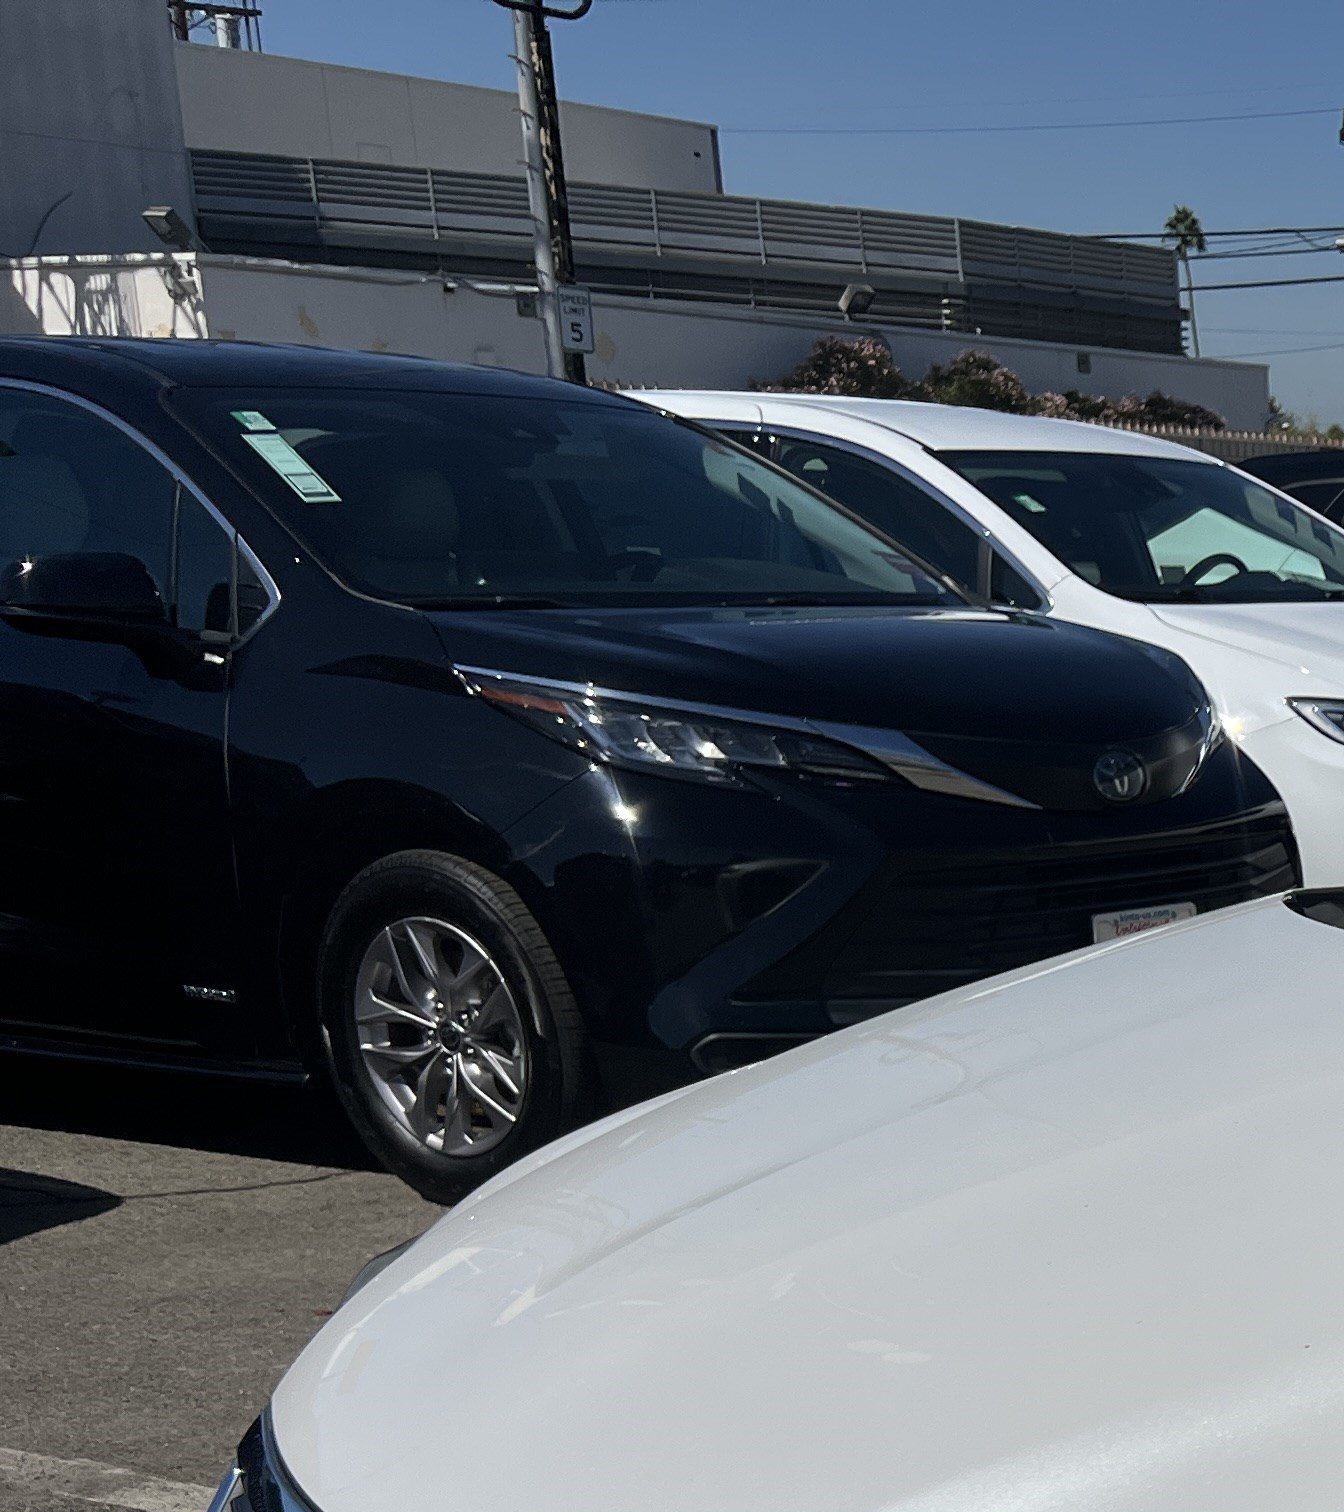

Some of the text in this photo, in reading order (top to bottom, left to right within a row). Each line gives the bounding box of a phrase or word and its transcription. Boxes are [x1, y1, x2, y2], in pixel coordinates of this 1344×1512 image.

[560, 293, 588, 305] SPEED
[563, 306, 586, 317] LIMIT
[570, 322, 583, 342] 5
